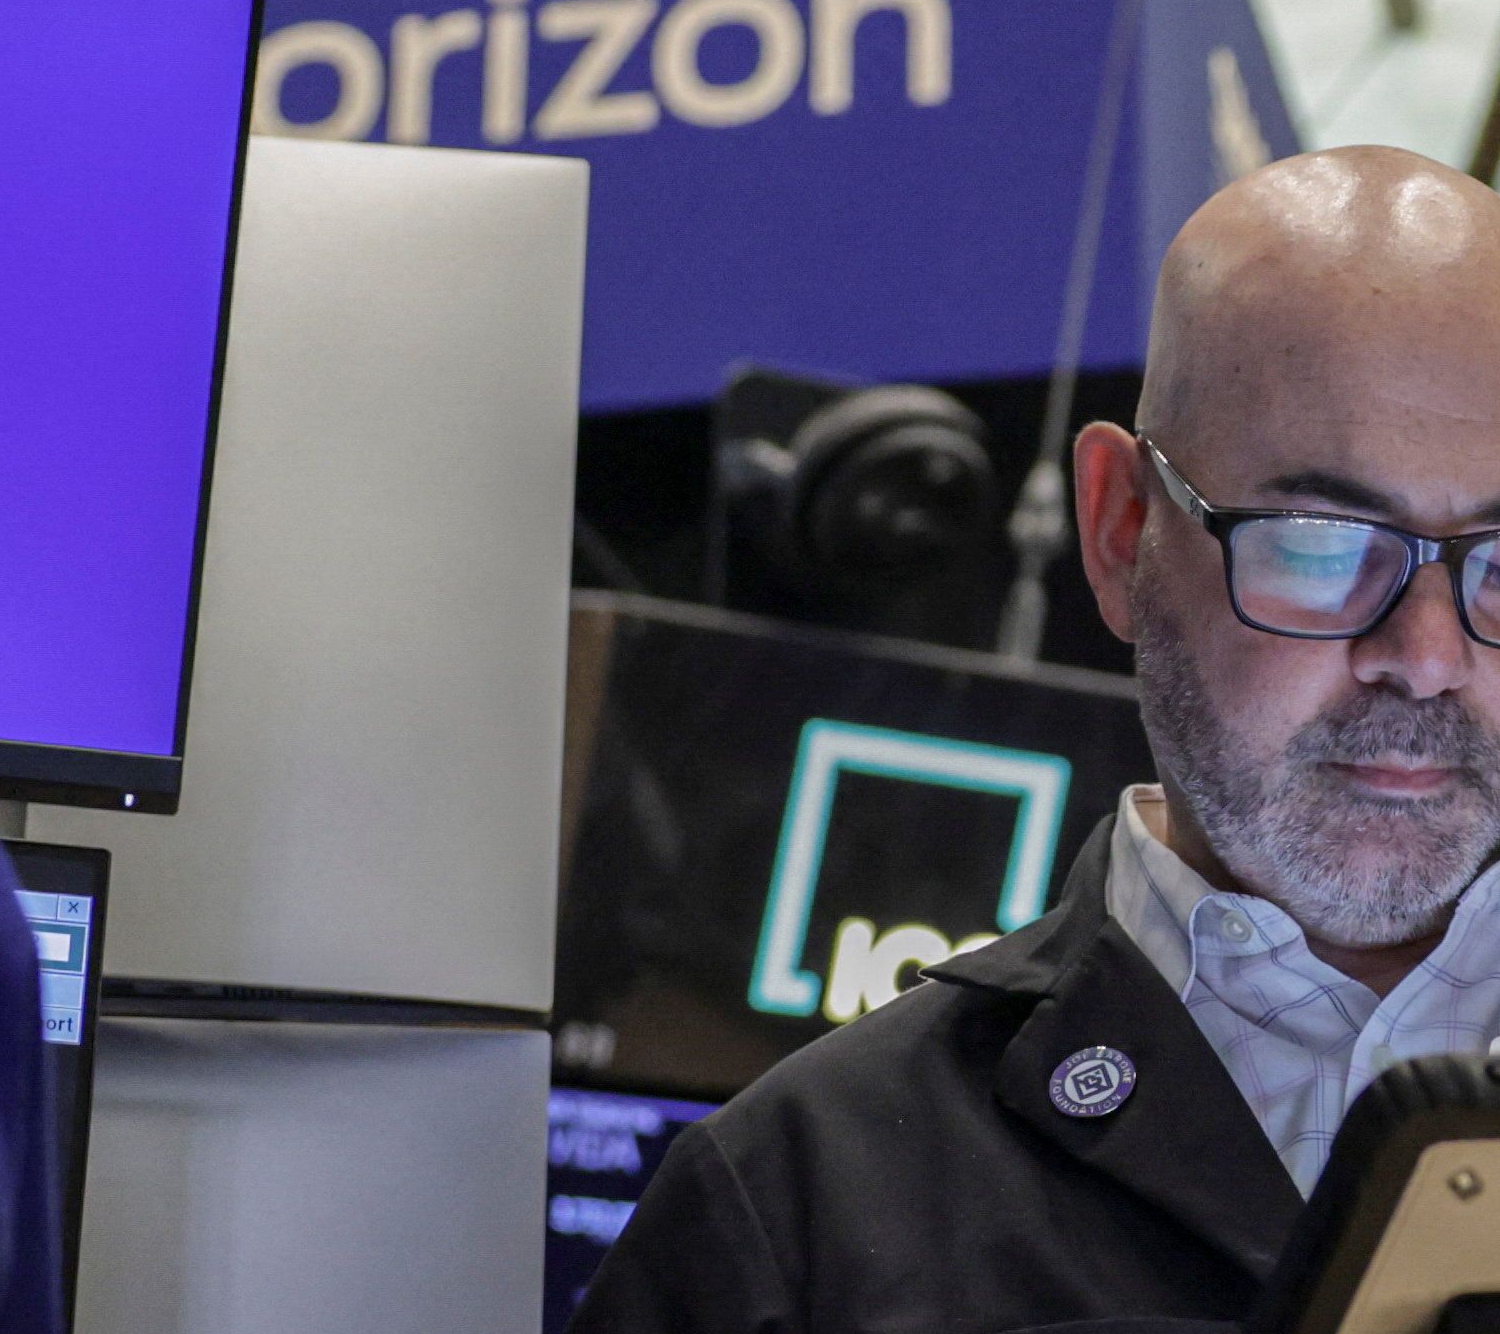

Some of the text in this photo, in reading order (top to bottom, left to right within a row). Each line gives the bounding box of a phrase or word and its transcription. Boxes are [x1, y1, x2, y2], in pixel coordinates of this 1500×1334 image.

[822, 916, 1002, 1024] IC
[46, 1016, 74, 1032] ort
[1052, 1079, 1122, 1114] FOUNDATION
